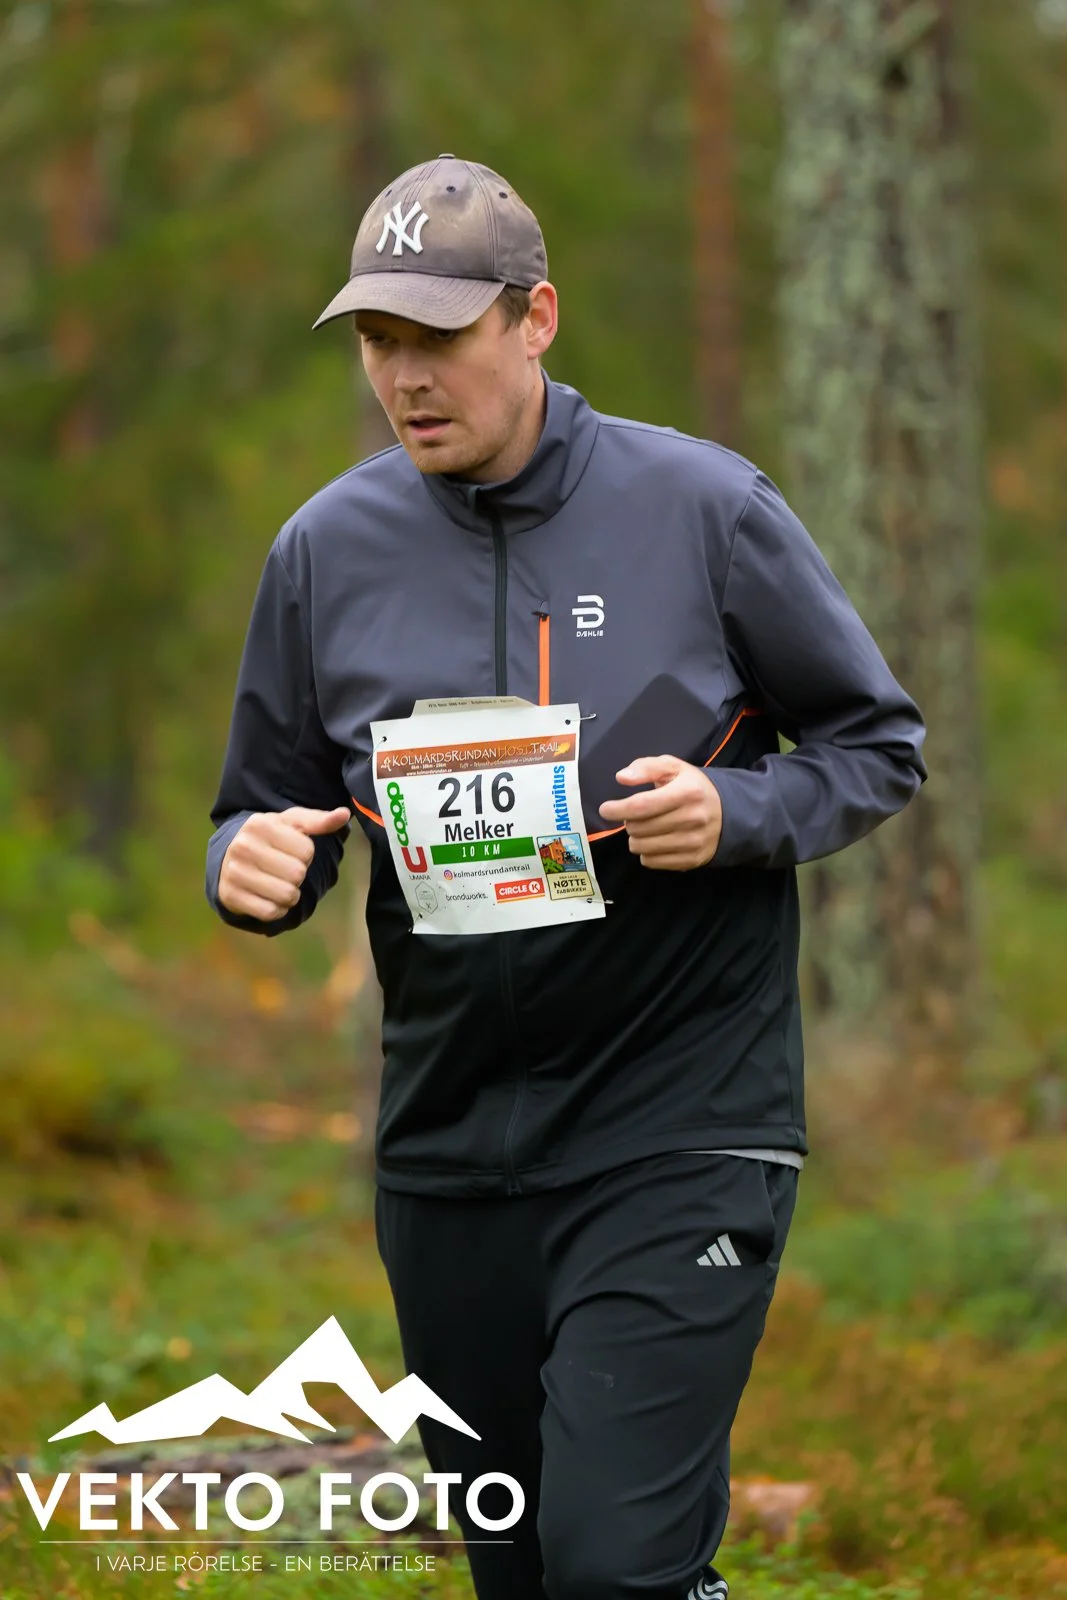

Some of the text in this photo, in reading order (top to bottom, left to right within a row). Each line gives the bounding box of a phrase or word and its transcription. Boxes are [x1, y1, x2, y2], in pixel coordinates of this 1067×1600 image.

[375, 201, 429, 256] NY
[437, 771, 516, 819] 216
[551, 764, 572, 832] Aktivitus
[386, 781, 409, 847] coop
[444, 819, 515, 843] Melker
[462, 843, 501, 858] 10 KM
[453, 863, 531, 879] kolmardsrundantrail
[498, 882, 540, 896] CIRCLE K
[553, 878, 587, 889] NØTTE
